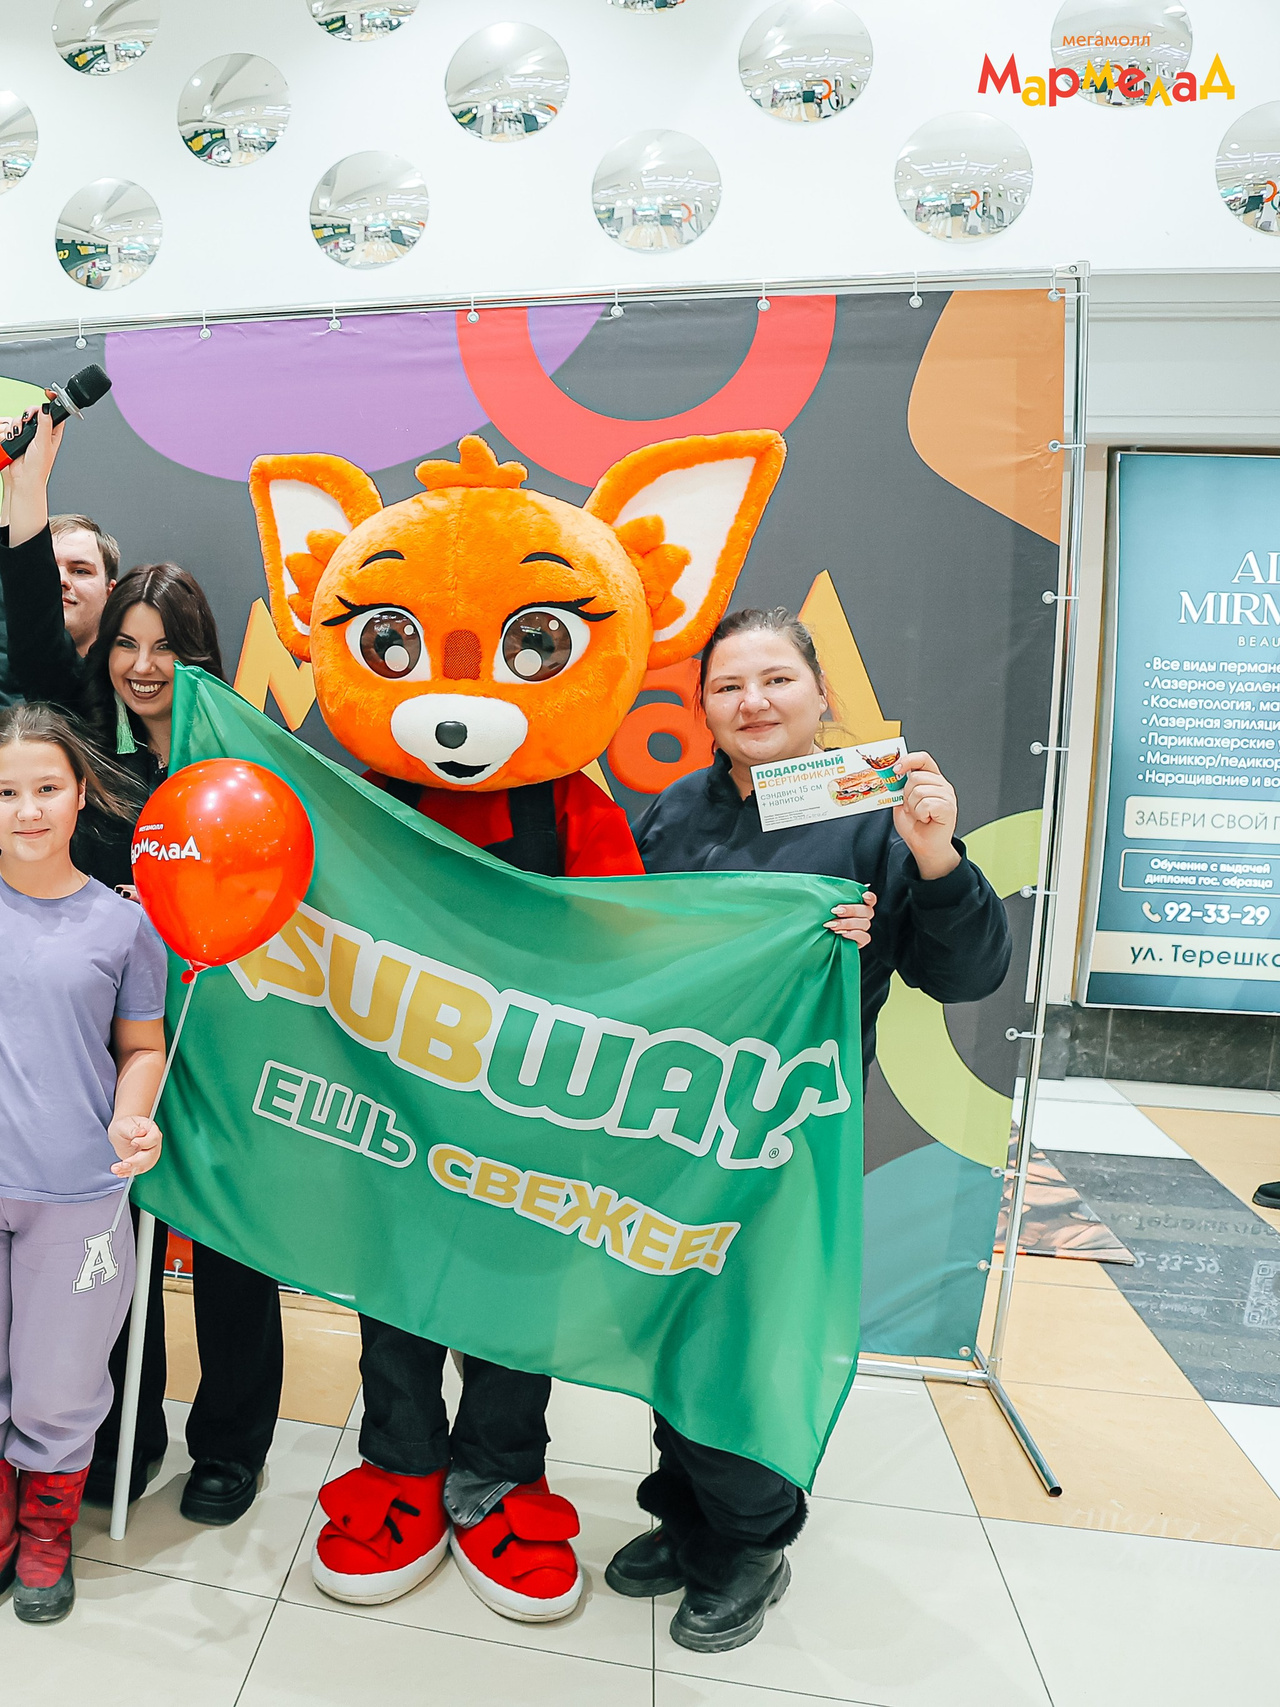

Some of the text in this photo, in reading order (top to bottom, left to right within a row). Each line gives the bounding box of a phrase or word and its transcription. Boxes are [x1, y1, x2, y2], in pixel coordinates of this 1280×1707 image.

[1238, 635, 1280, 648] BEAU
[1153, 656, 1180, 671] Все
[1183, 661, 1216, 673] виды
[1150, 675, 1225, 693] Лазерное
[1150, 694, 1256, 712] Косметология,
[1149, 713, 1220, 731] Лазерная
[1148, 732, 1275, 751] Парикмахерские
[756, 755, 844, 779] ПОДАРОЧНЫЙ
[768, 768, 835, 788] СЕРТИФИКАТ
[1145, 770, 1249, 786] Наращивание
[1252, 776, 1261, 787] и
[761, 788, 797, 800] сэндвич
[799, 784, 809, 793] 15
[877, 796, 904, 805] SUBWA
[769, 796, 804, 807] напиток
[1135, 810, 1205, 827] ЗАБЕРИ
[1211, 812, 1268, 830] СВОЙ
[1150, 857, 1271, 875] Обучение с выдачей
[1144, 873, 1273, 889] диплома гос. образца
[1164, 901, 1271, 926] 92-33-29
[1130, 945, 1163, 965] ул.
[232, 908, 846, 1164] SUBWAY
[257, 1064, 738, 1273] ЕШЬ СВЕЖЕЕ!
[73, 1228, 118, 1293] A
